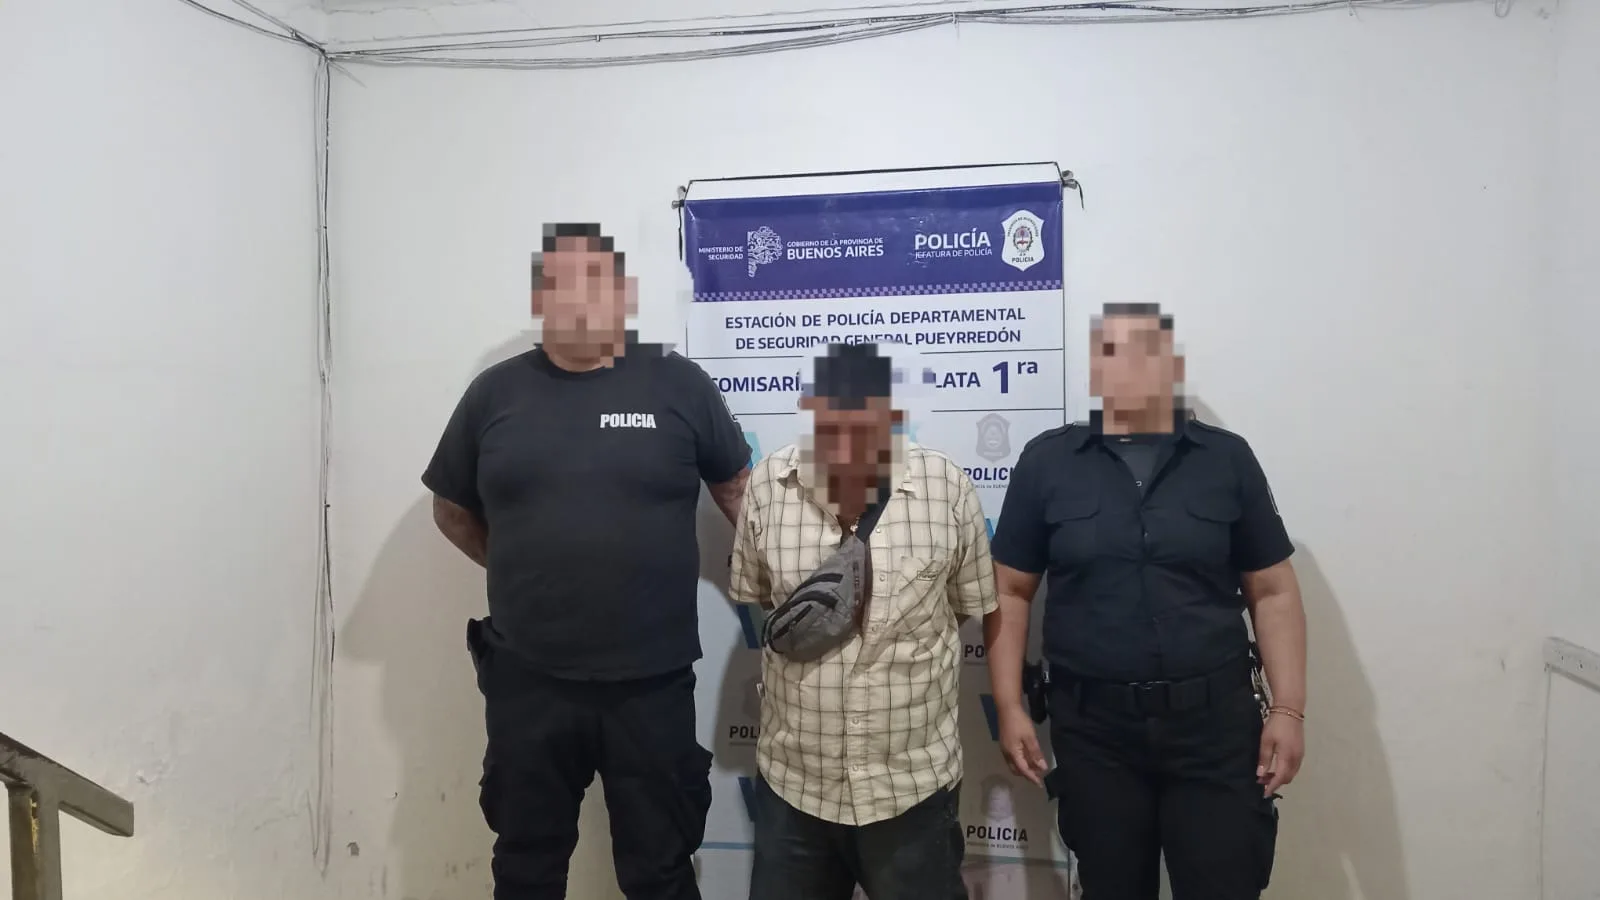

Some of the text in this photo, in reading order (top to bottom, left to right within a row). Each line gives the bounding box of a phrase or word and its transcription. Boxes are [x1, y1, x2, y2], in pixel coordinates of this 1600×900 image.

[914, 227, 991, 250] POLICÍA
[698, 246, 734, 254] MINISTERIO
[787, 244, 884, 260] BUENOS AIRES
[915, 247, 992, 259] JEFATURA DE POLICÍA
[725, 307, 1026, 329] ESTACIÓN DE POLICÍA DEPARTAMENTAL
[735, 337, 754, 350] DE
[915, 327, 1021, 345] PUEYRREDÓN
[711, 372, 804, 393] OMISARÍ
[992, 361, 1009, 394] 1
[1017, 360, 1039, 375] ra
[600, 413, 656, 428] POLICIA
[966, 825, 1029, 842] POLICIA
